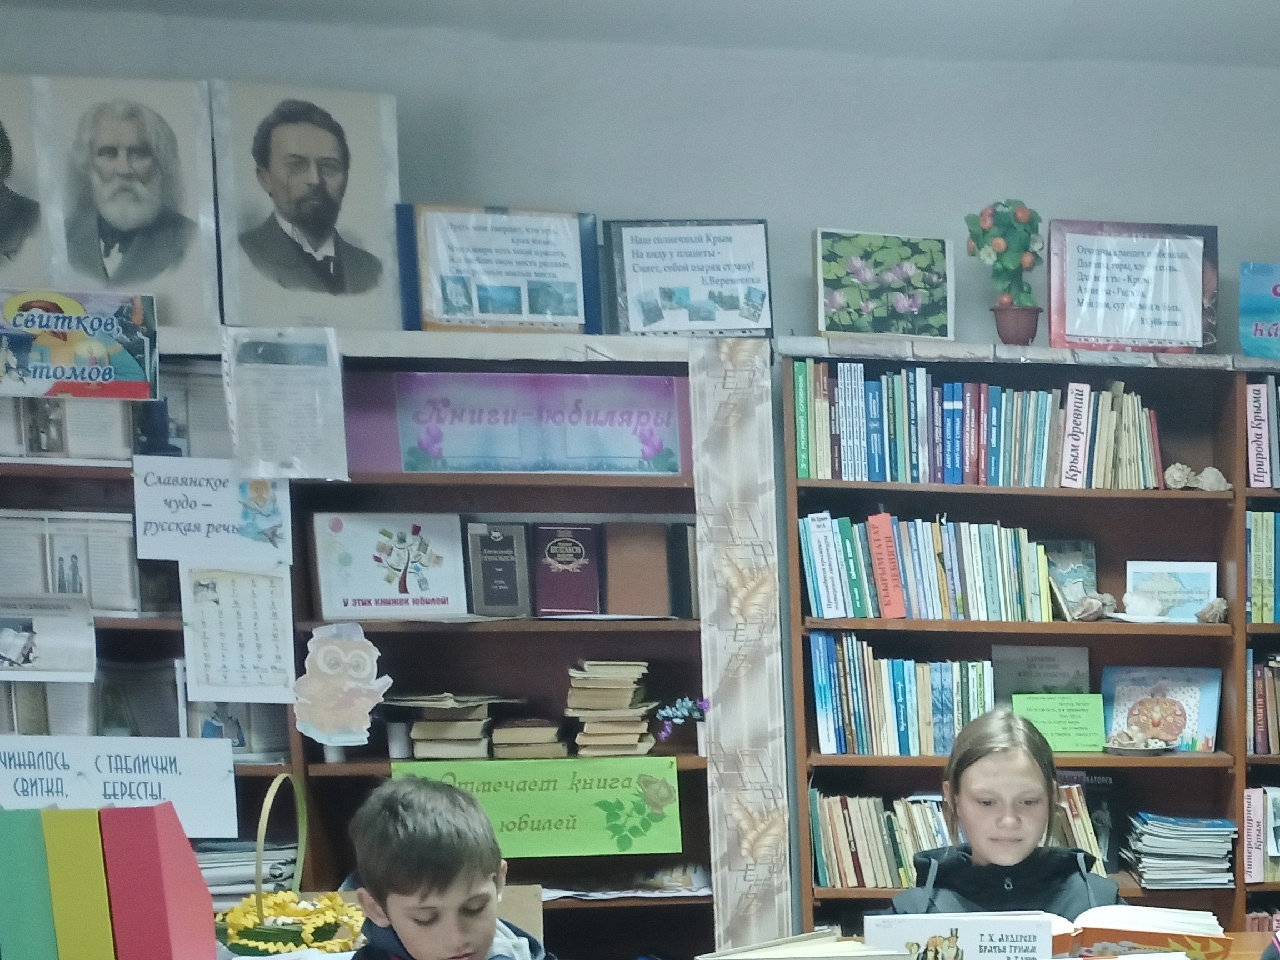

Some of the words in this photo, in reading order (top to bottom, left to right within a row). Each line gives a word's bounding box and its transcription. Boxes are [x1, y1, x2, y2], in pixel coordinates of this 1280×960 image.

[12, 312, 123, 337] свитков,
[30, 364, 114, 381] томов
[1066, 388, 1085, 442] древний
[1250, 388, 1265, 430] Крыма
[1065, 443, 1082, 483] Крым
[1251, 432, 1267, 484] Природа
[143, 471, 230, 492] Славянское
[163, 493, 198, 514] чудо
[143, 520, 202, 536] русская
[205, 522, 240, 538] речь
[567, 770, 634, 795] книга
[498, 812, 578, 834] юбилей
[1245, 794, 1254, 878] Литературный
[1254, 820, 1263, 851] Крым
[978, 945, 1007, 954] БРАТЬЯ
[1009, 944, 1037, 954] ГРИММ
[998, 933, 1037, 943] АНДЕРСЕН
